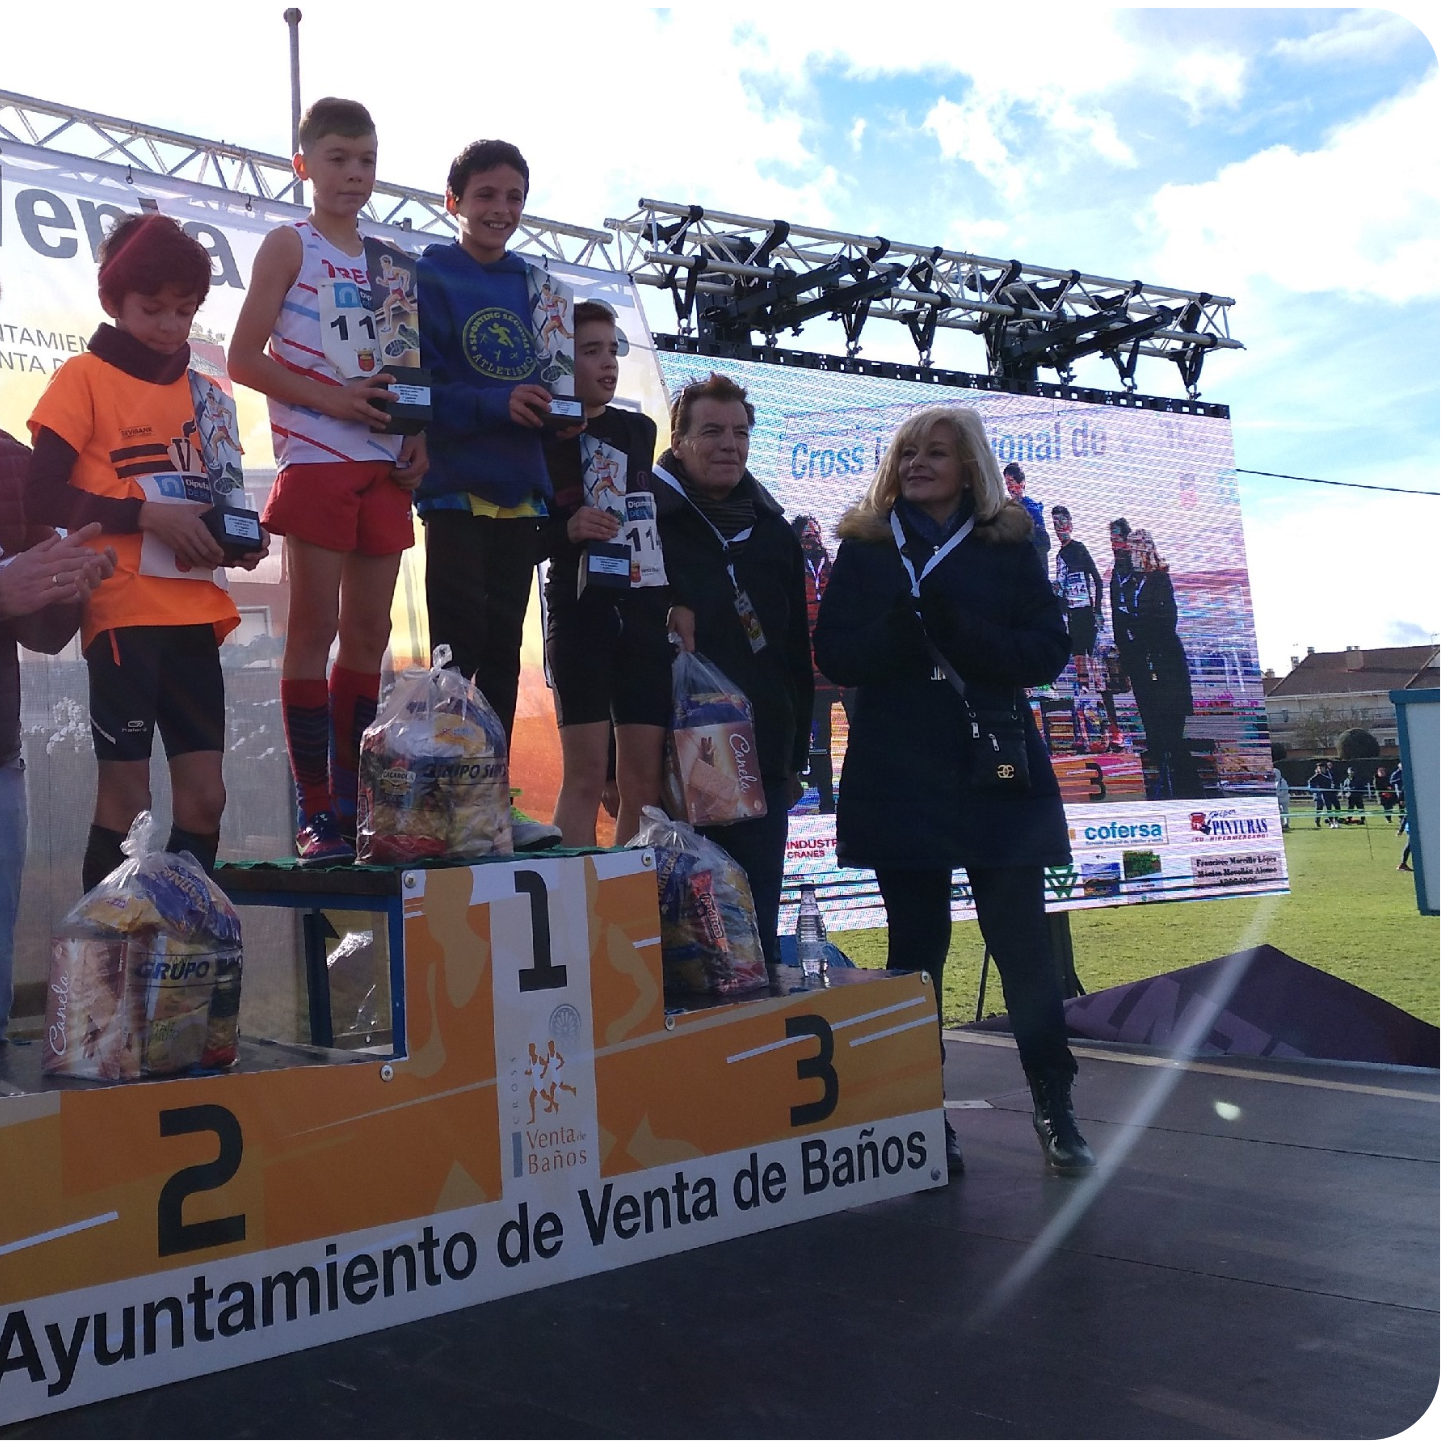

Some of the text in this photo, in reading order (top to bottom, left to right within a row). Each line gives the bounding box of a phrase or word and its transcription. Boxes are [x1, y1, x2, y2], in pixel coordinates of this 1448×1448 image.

[473, 353, 534, 376] ATLETISMO
[791, 443, 865, 480] Cross
[728, 733, 758, 794] Canela
[1084, 822, 1162, 840] cofersa
[1212, 818, 1268, 836] PINTURAS
[787, 850, 825, 859] CRANES
[514, 870, 567, 993] 1
[135, 961, 210, 980] GRUPO
[49, 971, 69, 1057] Canela
[785, 1014, 839, 1127] 3
[510, 1057, 520, 1124] CROSS
[526, 1126, 587, 1150] Venta de
[528, 1149, 587, 1175] Baños
[156, 1105, 246, 1257] 2
[497, 1203, 564, 1268] de
[579, 1171, 719, 1246] Venta
[734, 1153, 786, 1211] de
[801, 1128, 927, 1194] Baños
